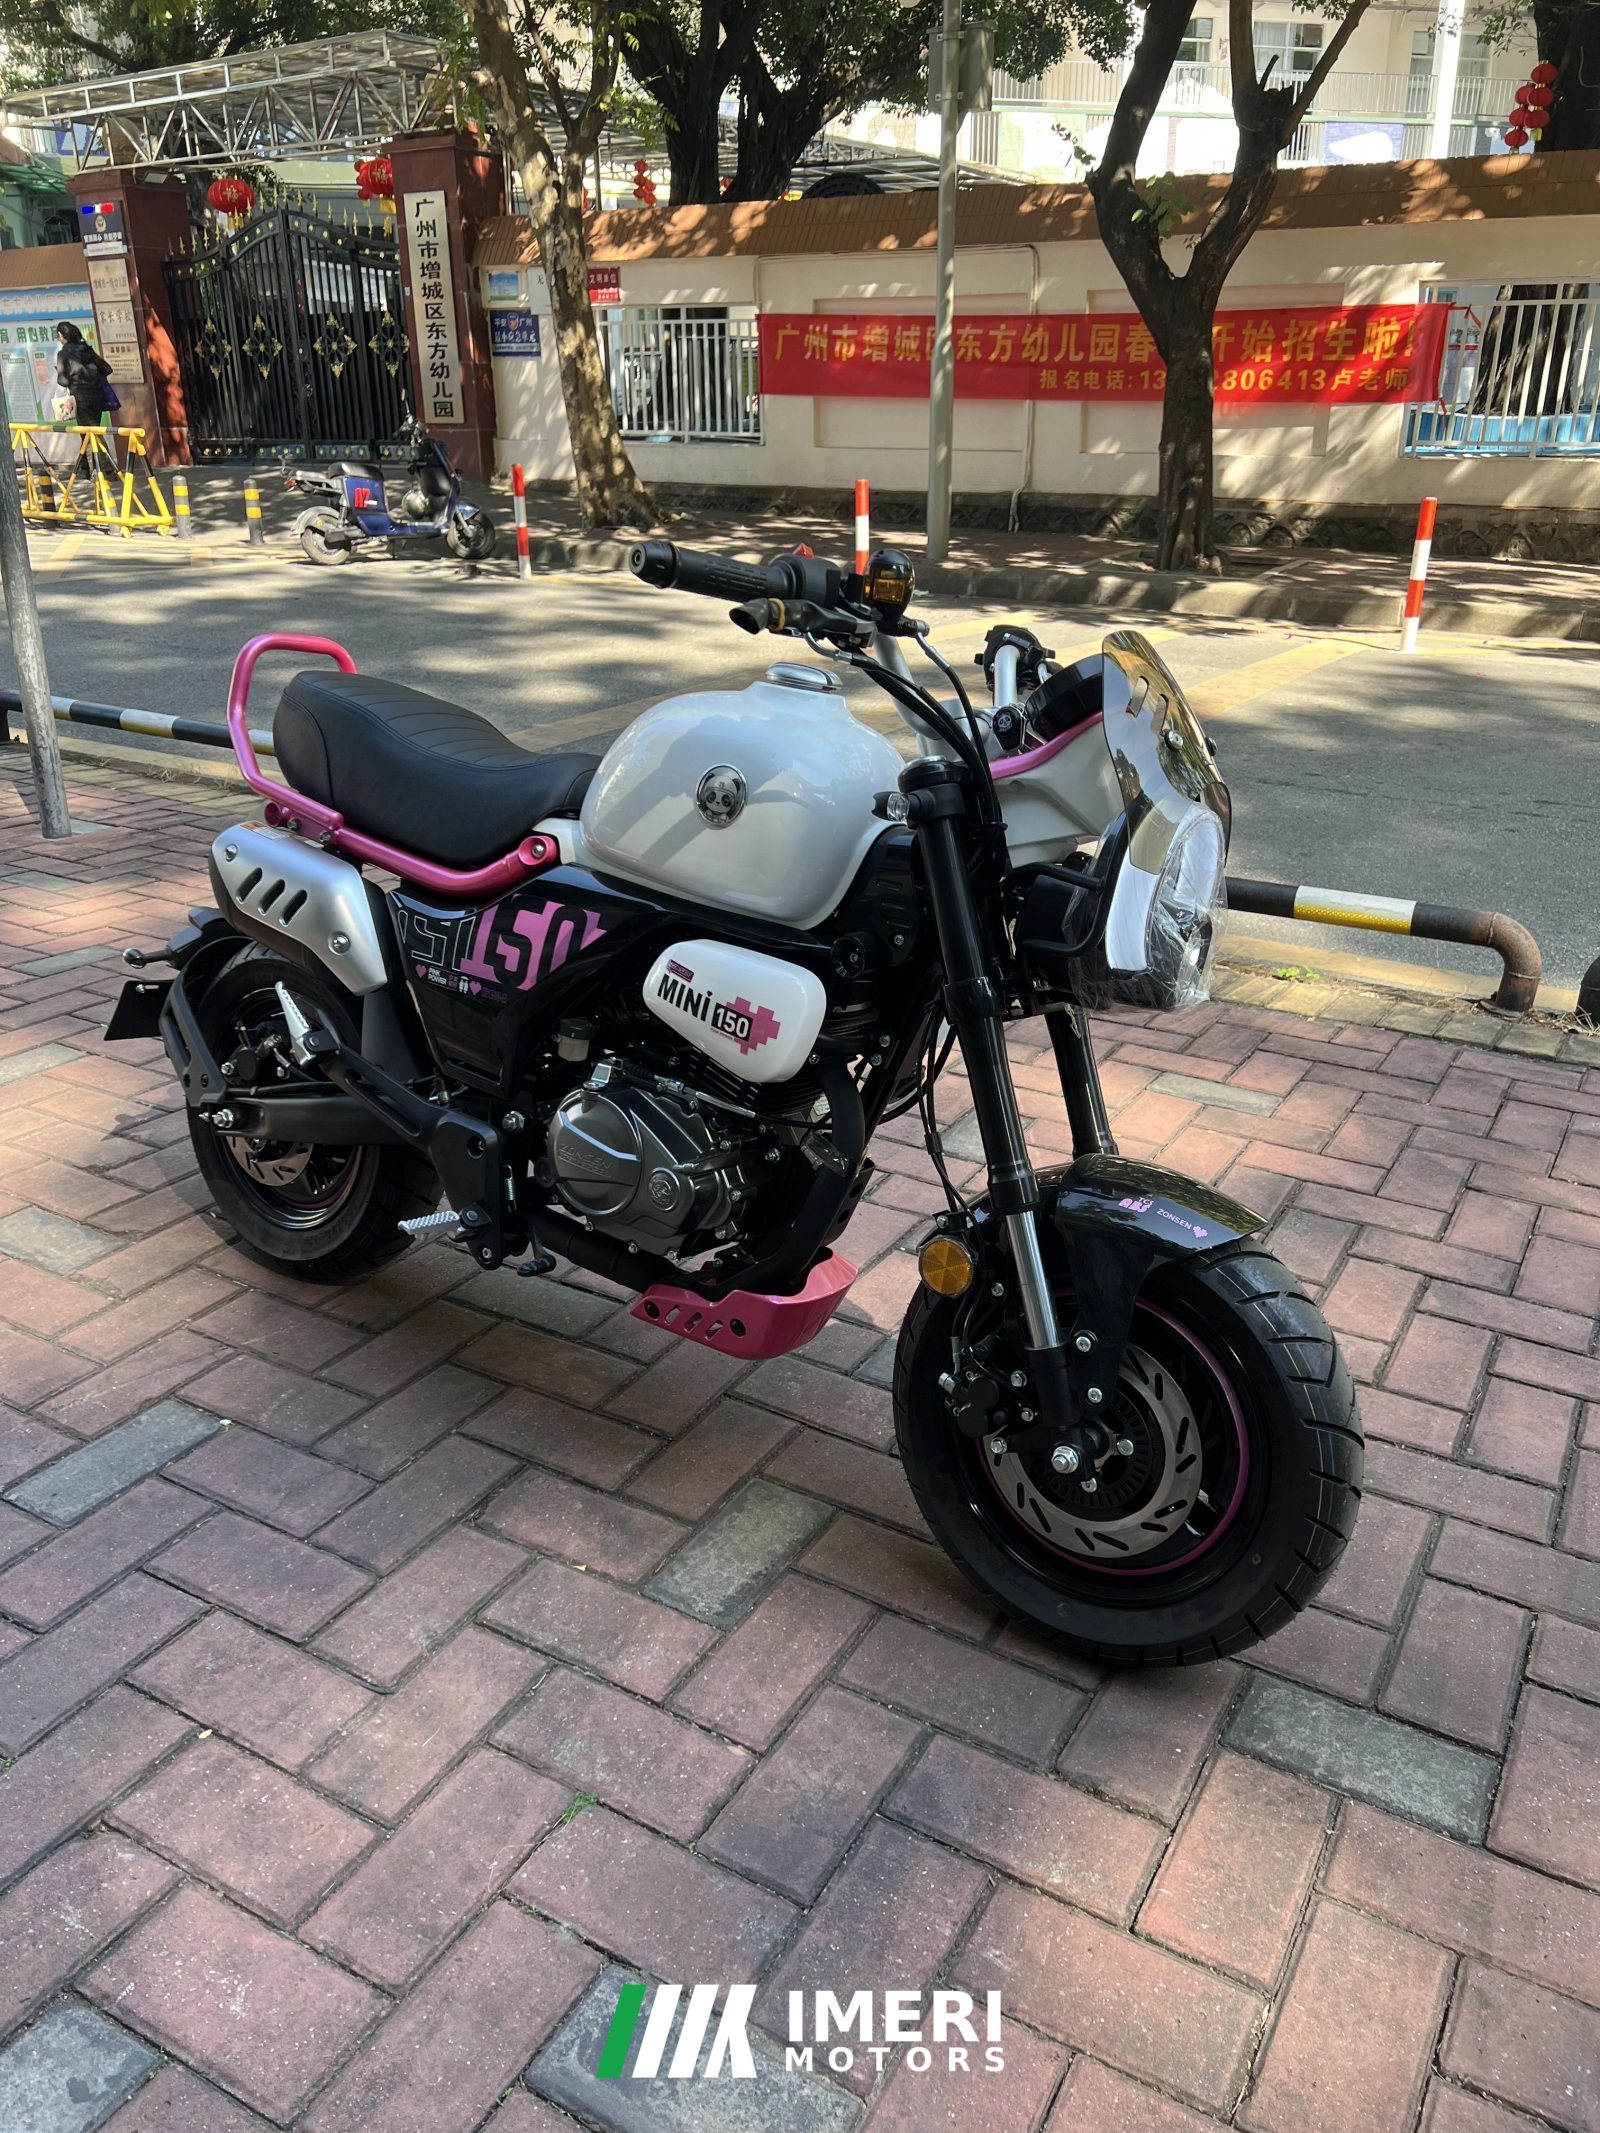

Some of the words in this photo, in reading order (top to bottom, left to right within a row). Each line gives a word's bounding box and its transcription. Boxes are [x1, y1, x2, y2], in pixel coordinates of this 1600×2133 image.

[415, 198, 454, 418] 广州市增城区东方幼儿园
[775, 317, 1415, 363] 广州市增城东方幼儿园春开始招生啦!
[716, 1008, 749, 1038] 150
[1156, 1208, 1192, 1230] ZONSEN
